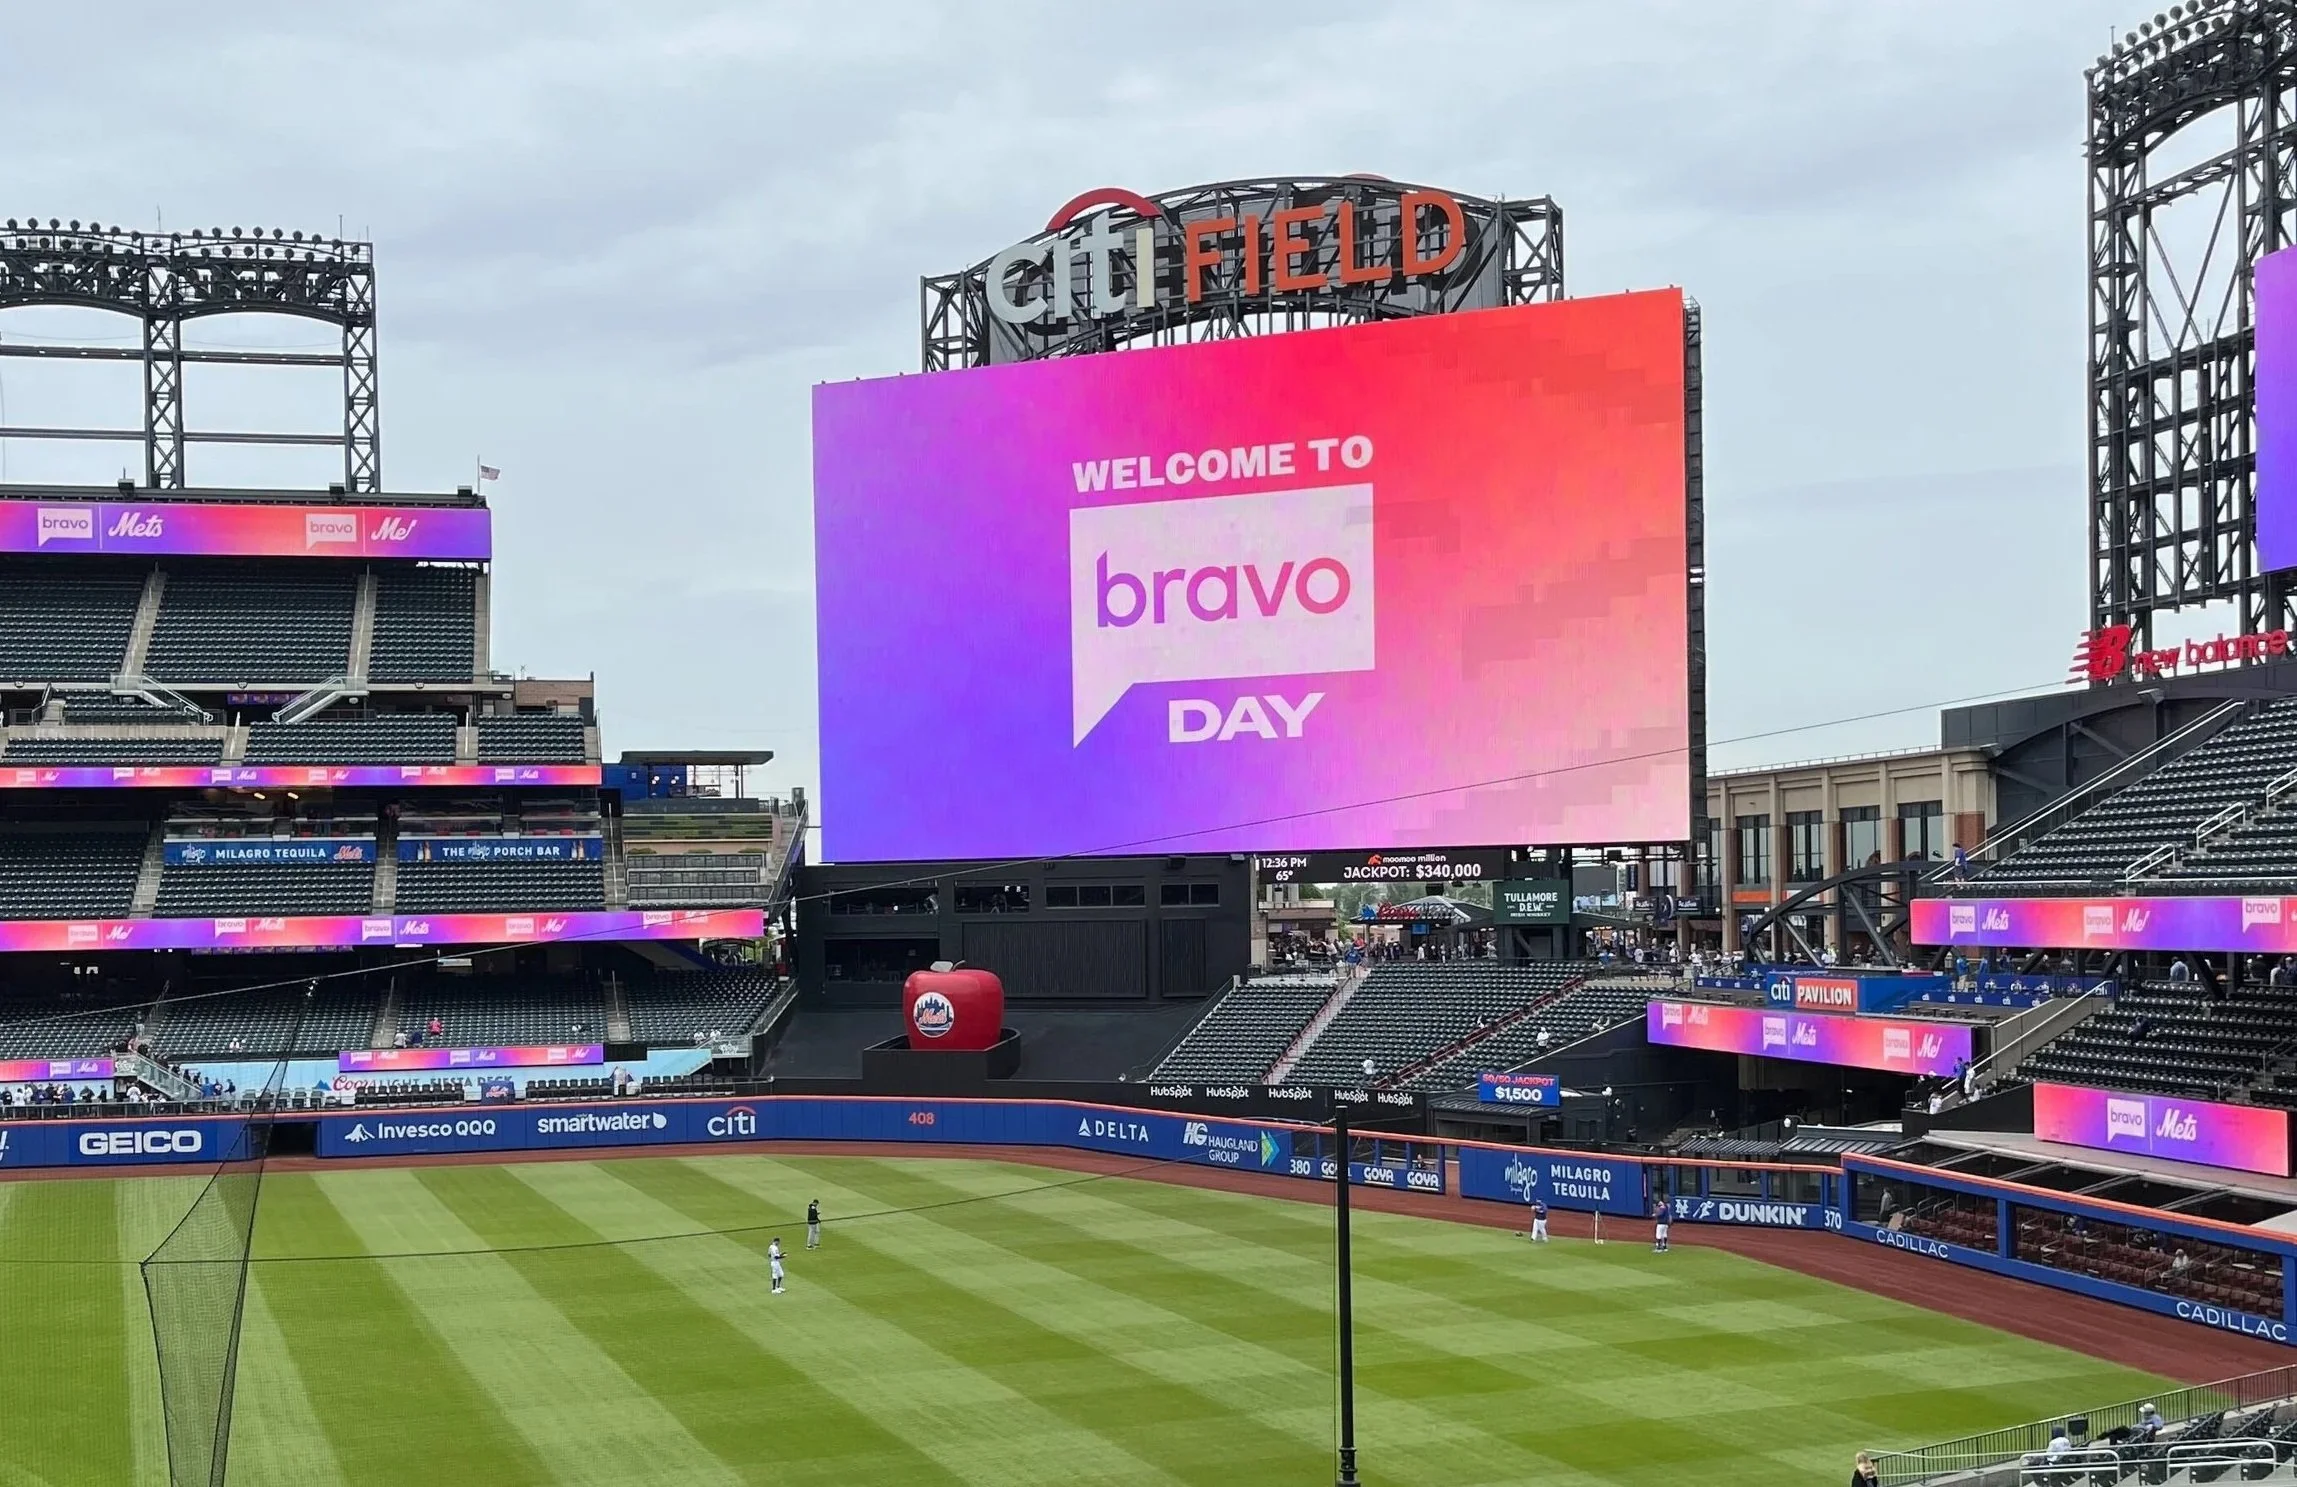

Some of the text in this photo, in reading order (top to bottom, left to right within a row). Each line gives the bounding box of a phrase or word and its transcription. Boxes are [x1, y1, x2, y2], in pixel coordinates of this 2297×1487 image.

[986, 188, 1466, 323] citi FIELD
[1072, 435, 1374, 493] WELCOME TO
[43, 516, 89, 530] bravo
[108, 512, 163, 538] Mets
[310, 521, 353, 534] bravo
[1096, 550, 1350, 628] bravo
[2134, 647, 2181, 673] new
[2185, 629, 2288, 666] balance
[1168, 692, 1326, 743] DAY
[216, 849, 270, 859] MILAGRO
[274, 848, 326, 858] TEQUILA
[443, 847, 465, 857] THE
[494, 846, 533, 856] PORCH
[536, 846, 560, 856] BAR
[1383, 854, 1446, 863] moomoo million
[1262, 857, 1308, 868] 12:36 PM
[1275, 870, 1294, 881] 65°
[1344, 864, 1482, 879] JACKPOT: $340,000
[1504, 892, 1558, 902] TULLAMORE
[2245, 901, 2278, 914] bravo
[217, 919, 245, 928] bravo
[400, 921, 429, 935] Mets
[1982, 908, 2009, 931] Mets
[1771, 976, 1853, 1006] citi PAVILION
[1792, 1022, 1816, 1046] Mets
[1512, 1076, 1554, 1086] JACKPOT
[1150, 1085, 1192, 1098] HubSpot
[1206, 1086, 1249, 1099] HubSpot
[1268, 1087, 1312, 1101] HubSpot
[1334, 1088, 1369, 1103] HubSpot
[1377, 1091, 1413, 1106] HubSpot
[1495, 1086, 1542, 1101] $1,500
[538, 1112, 650, 1133] smartwater
[707, 1106, 756, 1136] citi
[909, 1112, 935, 1125] 408
[2110, 1106, 2142, 1127] bravo
[2156, 1107, 2197, 1141] Mets
[378, 1119, 496, 1139] Invesco QQQ
[1095, 1120, 1149, 1142] DELTA
[79, 1130, 202, 1156] GEICO
[1208, 1136, 1258, 1152] HAUGLAND
[1208, 1149, 1239, 1163] GROUP
[1289, 1159, 1310, 1175] 380
[1363, 1166, 1394, 1181] GOYA
[1407, 1171, 1439, 1187] GOYA
[1551, 1164, 1611, 1184] MILAGRO
[1553, 1182, 1610, 1201] TEQUILA
[1718, 1202, 1807, 1226] DUNKIN'
[1824, 1210, 1842, 1230] 370
[1876, 1229, 1948, 1259] CADILLAC
[2176, 1301, 2287, 1342] CADILLAC
